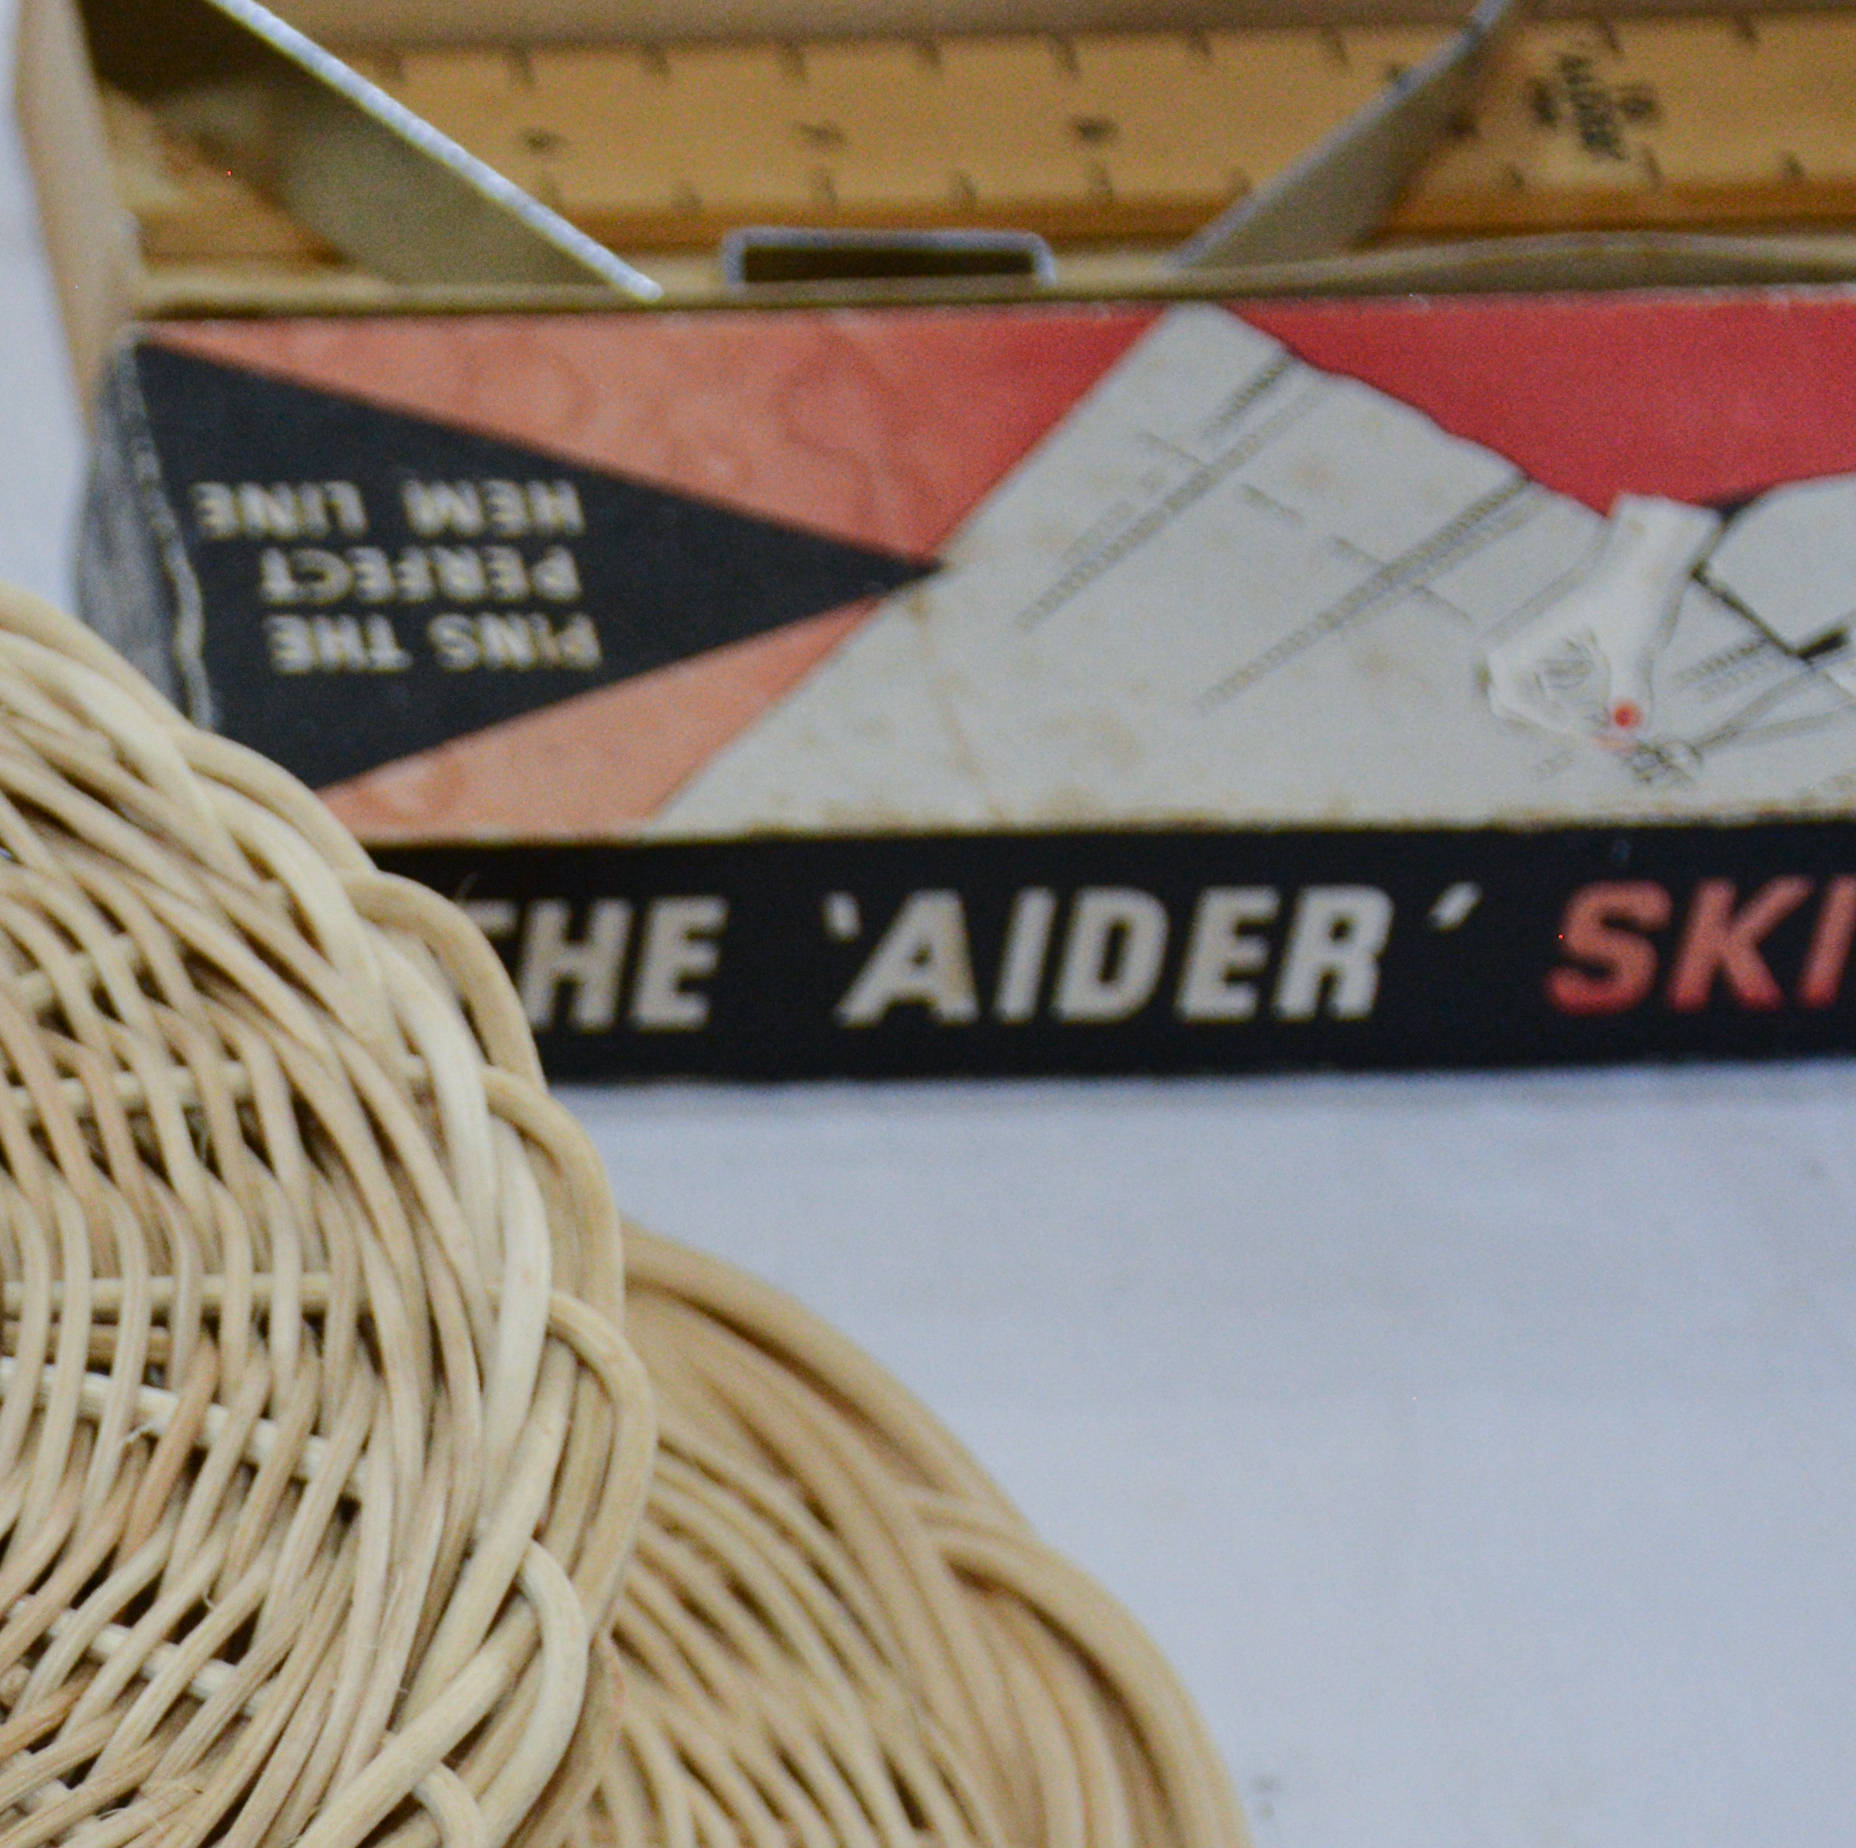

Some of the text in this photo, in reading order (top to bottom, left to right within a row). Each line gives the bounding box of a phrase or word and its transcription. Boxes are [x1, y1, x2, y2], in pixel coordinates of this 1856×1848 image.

[191, 478, 587, 543] HEM LINE
[260, 545, 583, 605] PERFECT
[265, 611, 603, 675] PINS THE
